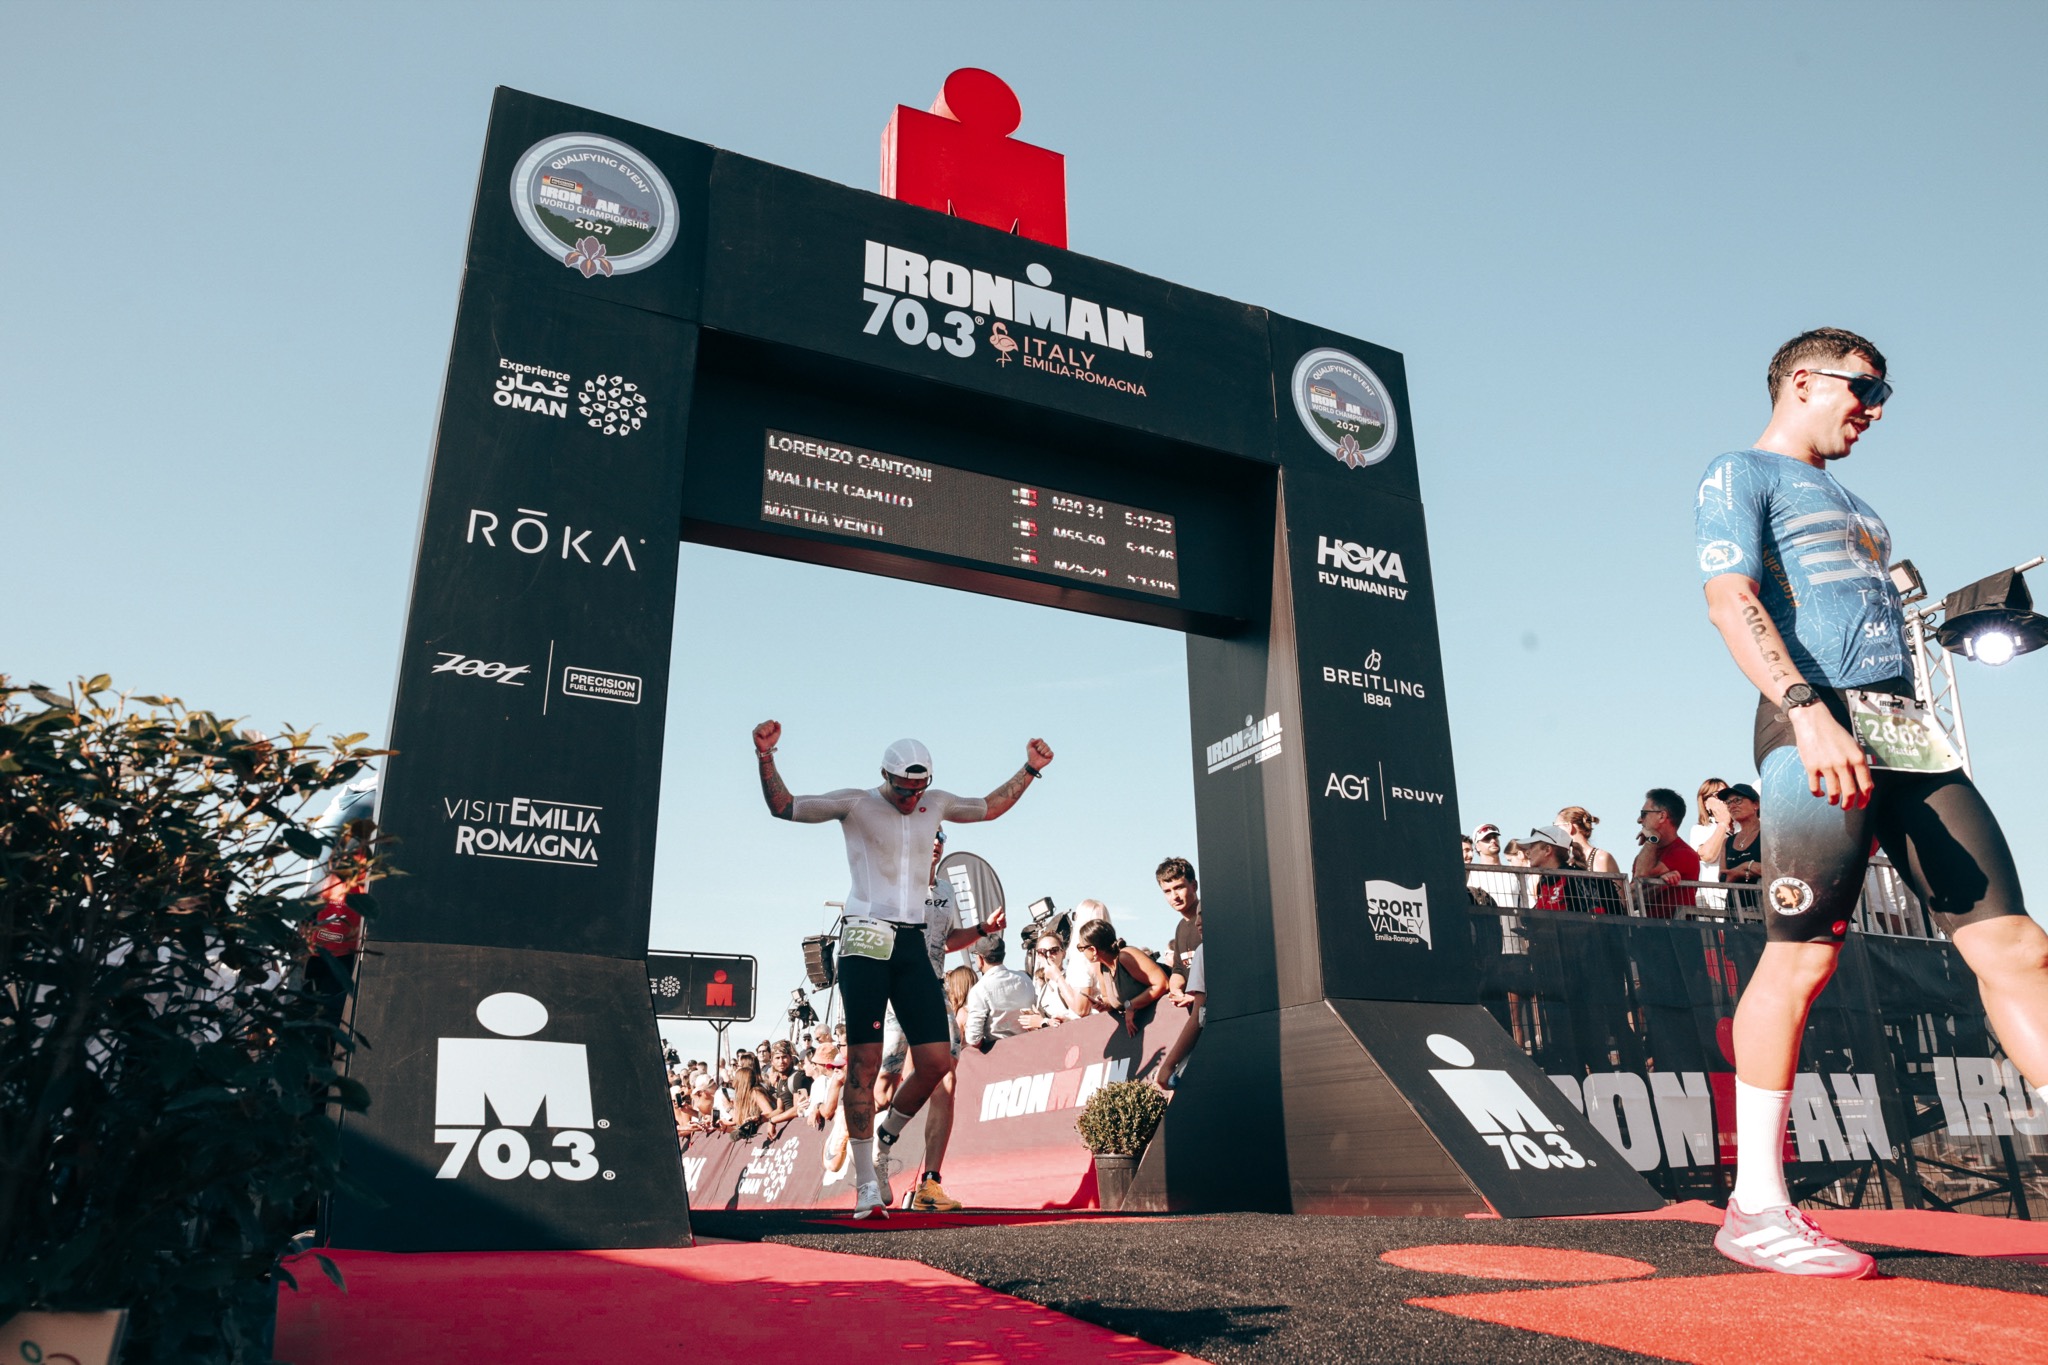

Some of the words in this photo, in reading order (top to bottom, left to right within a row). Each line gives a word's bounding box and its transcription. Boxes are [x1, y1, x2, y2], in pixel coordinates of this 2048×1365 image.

[551, 153, 617, 170] QUALIFYING
[618, 166, 650, 194] EVENT
[540, 185, 620, 216] IRONMAN
[540, 197, 575, 211] WORLD
[577, 206, 649, 231] CHAMPIONSHIP
[575, 218, 613, 236] 2027
[864, 240, 1146, 357] IRONMAN
[862, 287, 976, 358] 70.3
[1024, 336, 1095, 369] ITALY
[499, 358, 571, 381] Experience
[1023, 356, 1147, 397] EMILIA-ROMAGNA
[1313, 365, 1352, 380] QUALIFYING
[1353, 373, 1375, 396] EVENT
[493, 390, 567, 418] OMAN
[1312, 402, 1334, 414] WORLD
[1336, 420, 1360, 433] 2027
[769, 435, 853, 464] LORENZO
[857, 455, 932, 482] CANTONI
[1317, 536, 1407, 583] HOKA
[1318, 571, 1338, 585] FLY
[1341, 576, 1387, 597] HUMAN
[1389, 586, 1407, 600] FLY
[569, 683, 588, 691] FUEL
[595, 687, 634, 698] HYDRATION
[570, 673, 635, 691] PRECISION
[1323, 667, 1425, 698] BREITLING
[1363, 692, 1392, 707] 1884
[1325, 772, 1369, 801] AG1
[1392, 787, 1444, 804] ROUVY
[455, 825, 599, 861] ROMAGNA
[946, 864, 979, 929] IRON
[1367, 898, 1423, 918] SPORT
[847, 929, 884, 946] 2273
[1368, 915, 1424, 934] VALLEY
[1375, 933, 1419, 944] Emilia-Romagna
[1547, 1072, 1898, 1172] ONAN
[434, 1129, 599, 1181] 70.3
[1482, 1133, 1586, 1170] 70.3
